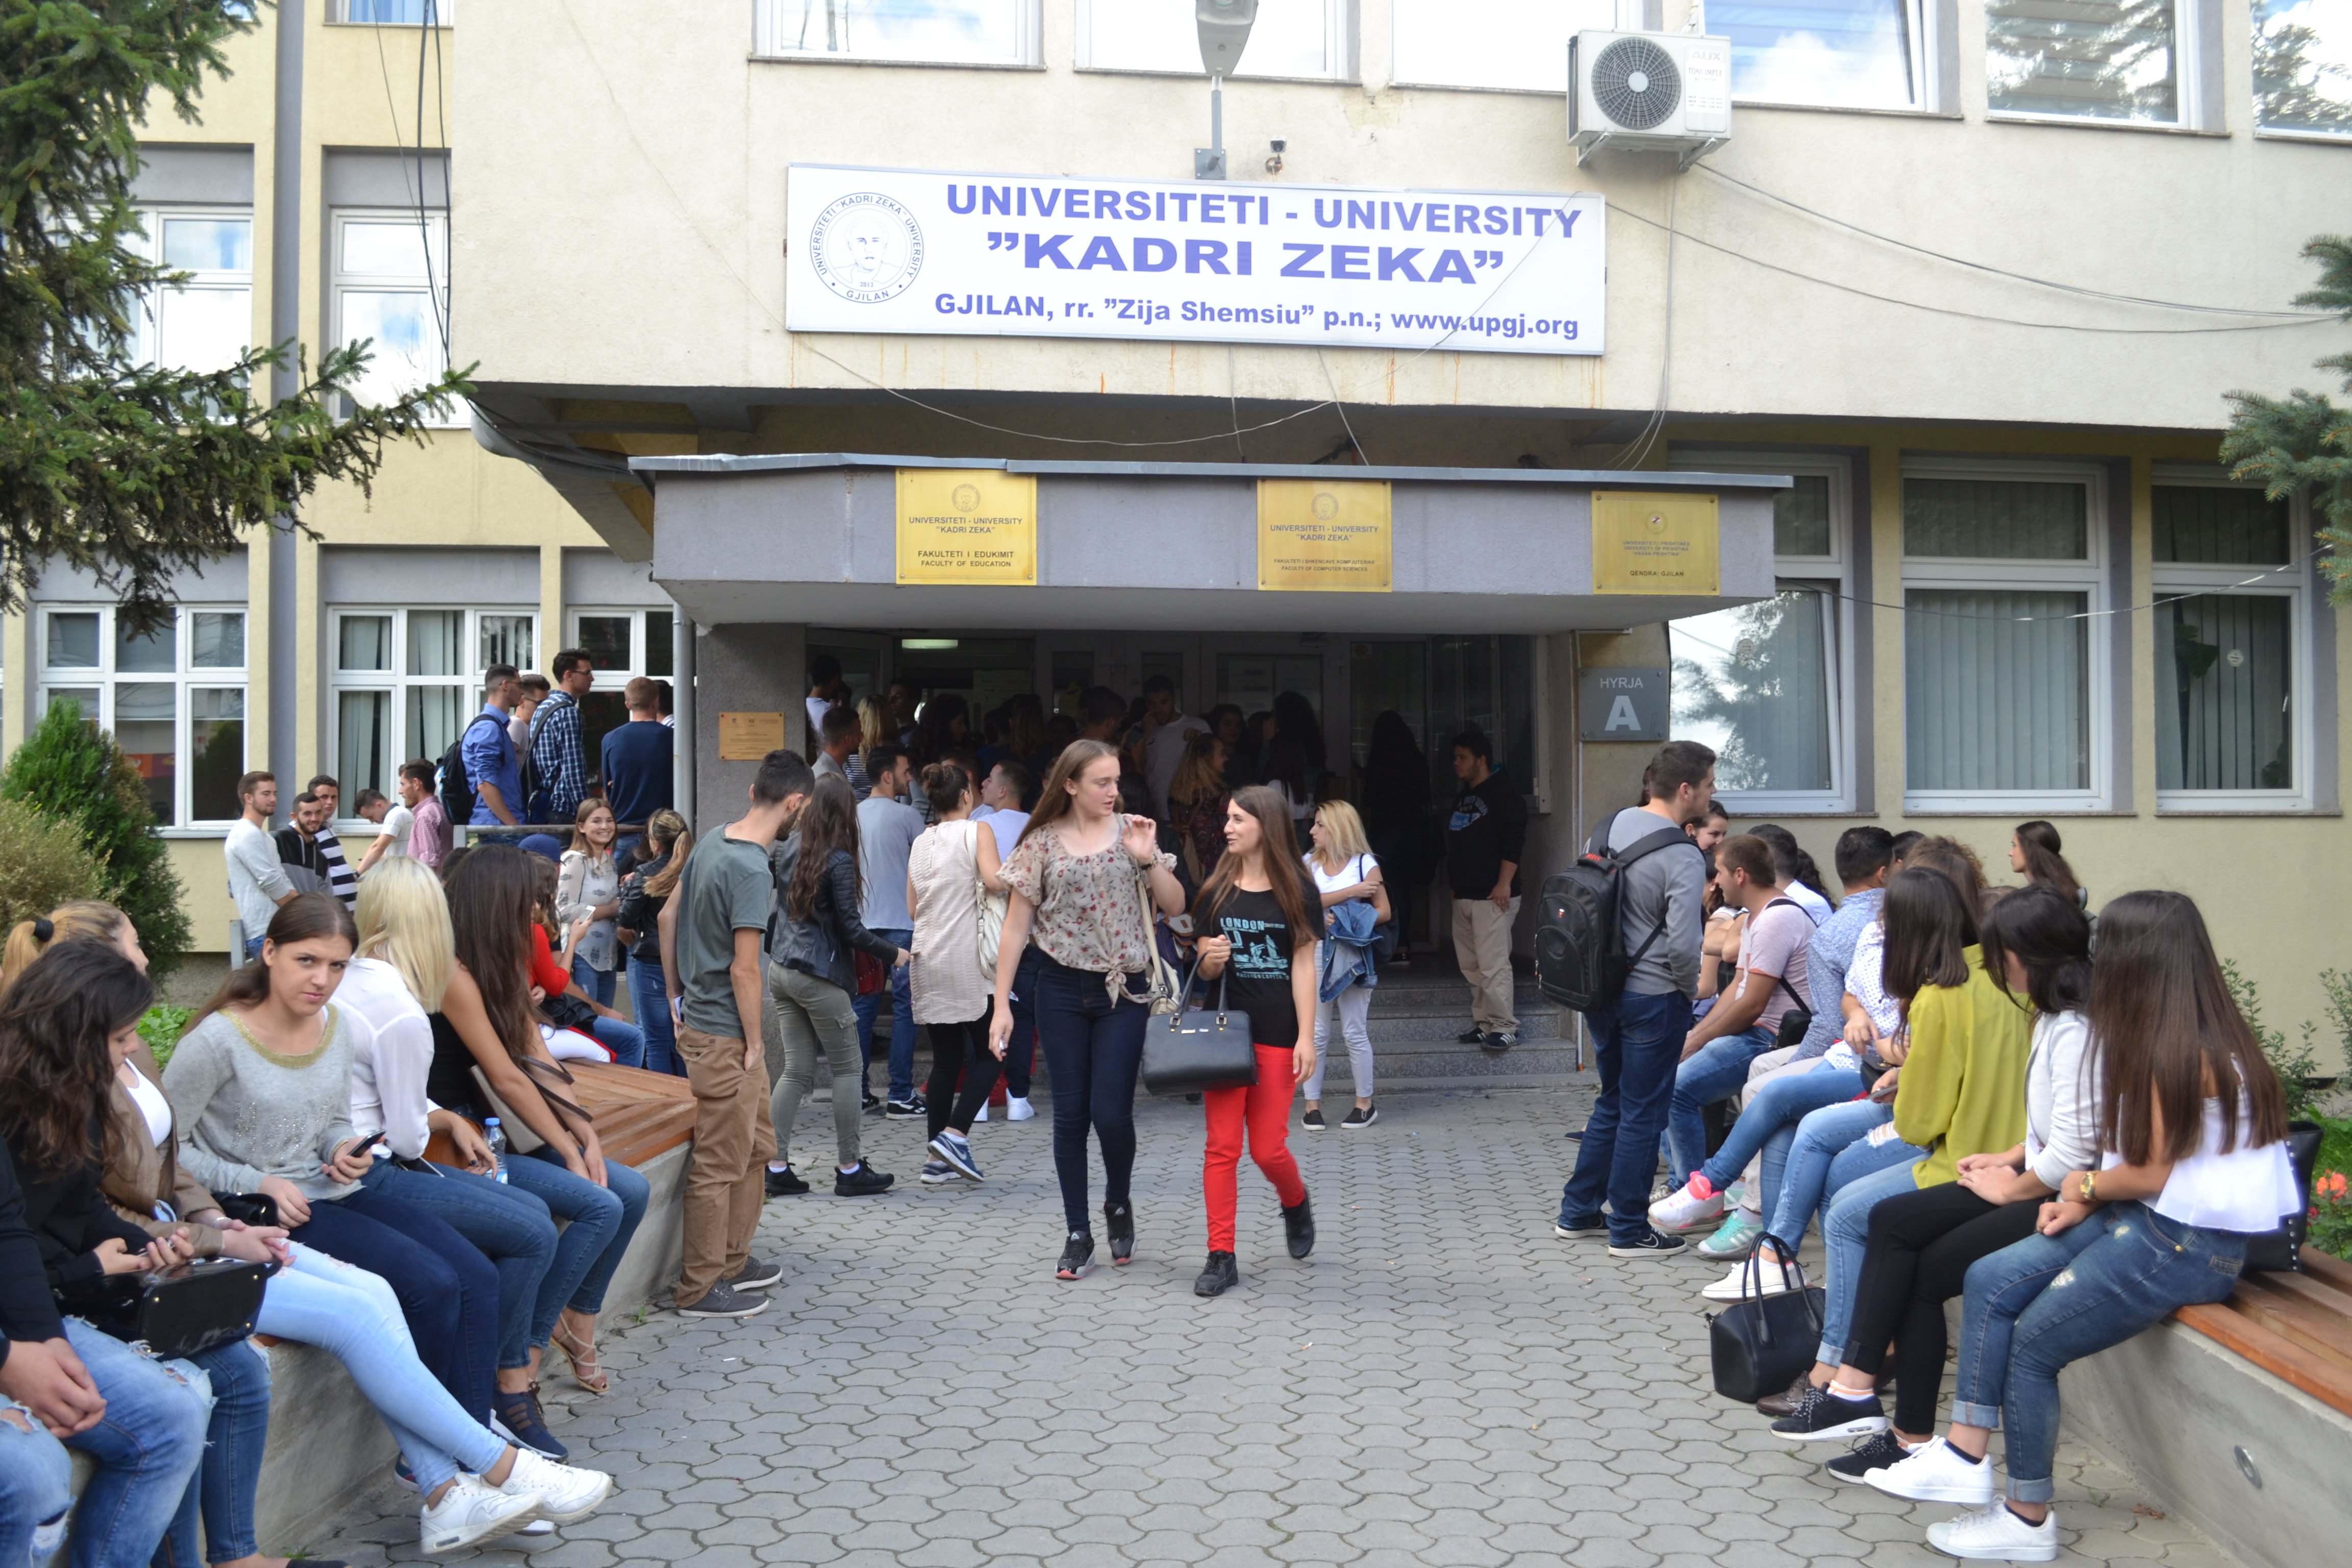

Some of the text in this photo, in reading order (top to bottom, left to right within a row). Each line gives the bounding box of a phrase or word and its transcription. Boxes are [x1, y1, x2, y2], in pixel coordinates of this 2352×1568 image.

[1691, 51, 1721, 60] AUX
[948, 184, 1268, 225] UNIVERSITETI
[1315, 199, 1582, 238] UNIVERSITY
[813, 207, 837, 276] UNIVERSITETI
[904, 218, 921, 279] UNIVERSITY
[846, 290, 890, 302] GJILAN
[936, 293, 1054, 321] GJILAN,
[1065, 303, 1094, 318] rr.
[1324, 311, 1381, 332] p.n.;
[1391, 314, 1578, 340] www.upgj.org
[1600, 677, 1644, 689] HYRJA
[1604, 695, 1642, 731] A
[1220, 917, 1265, 931] LONDON
